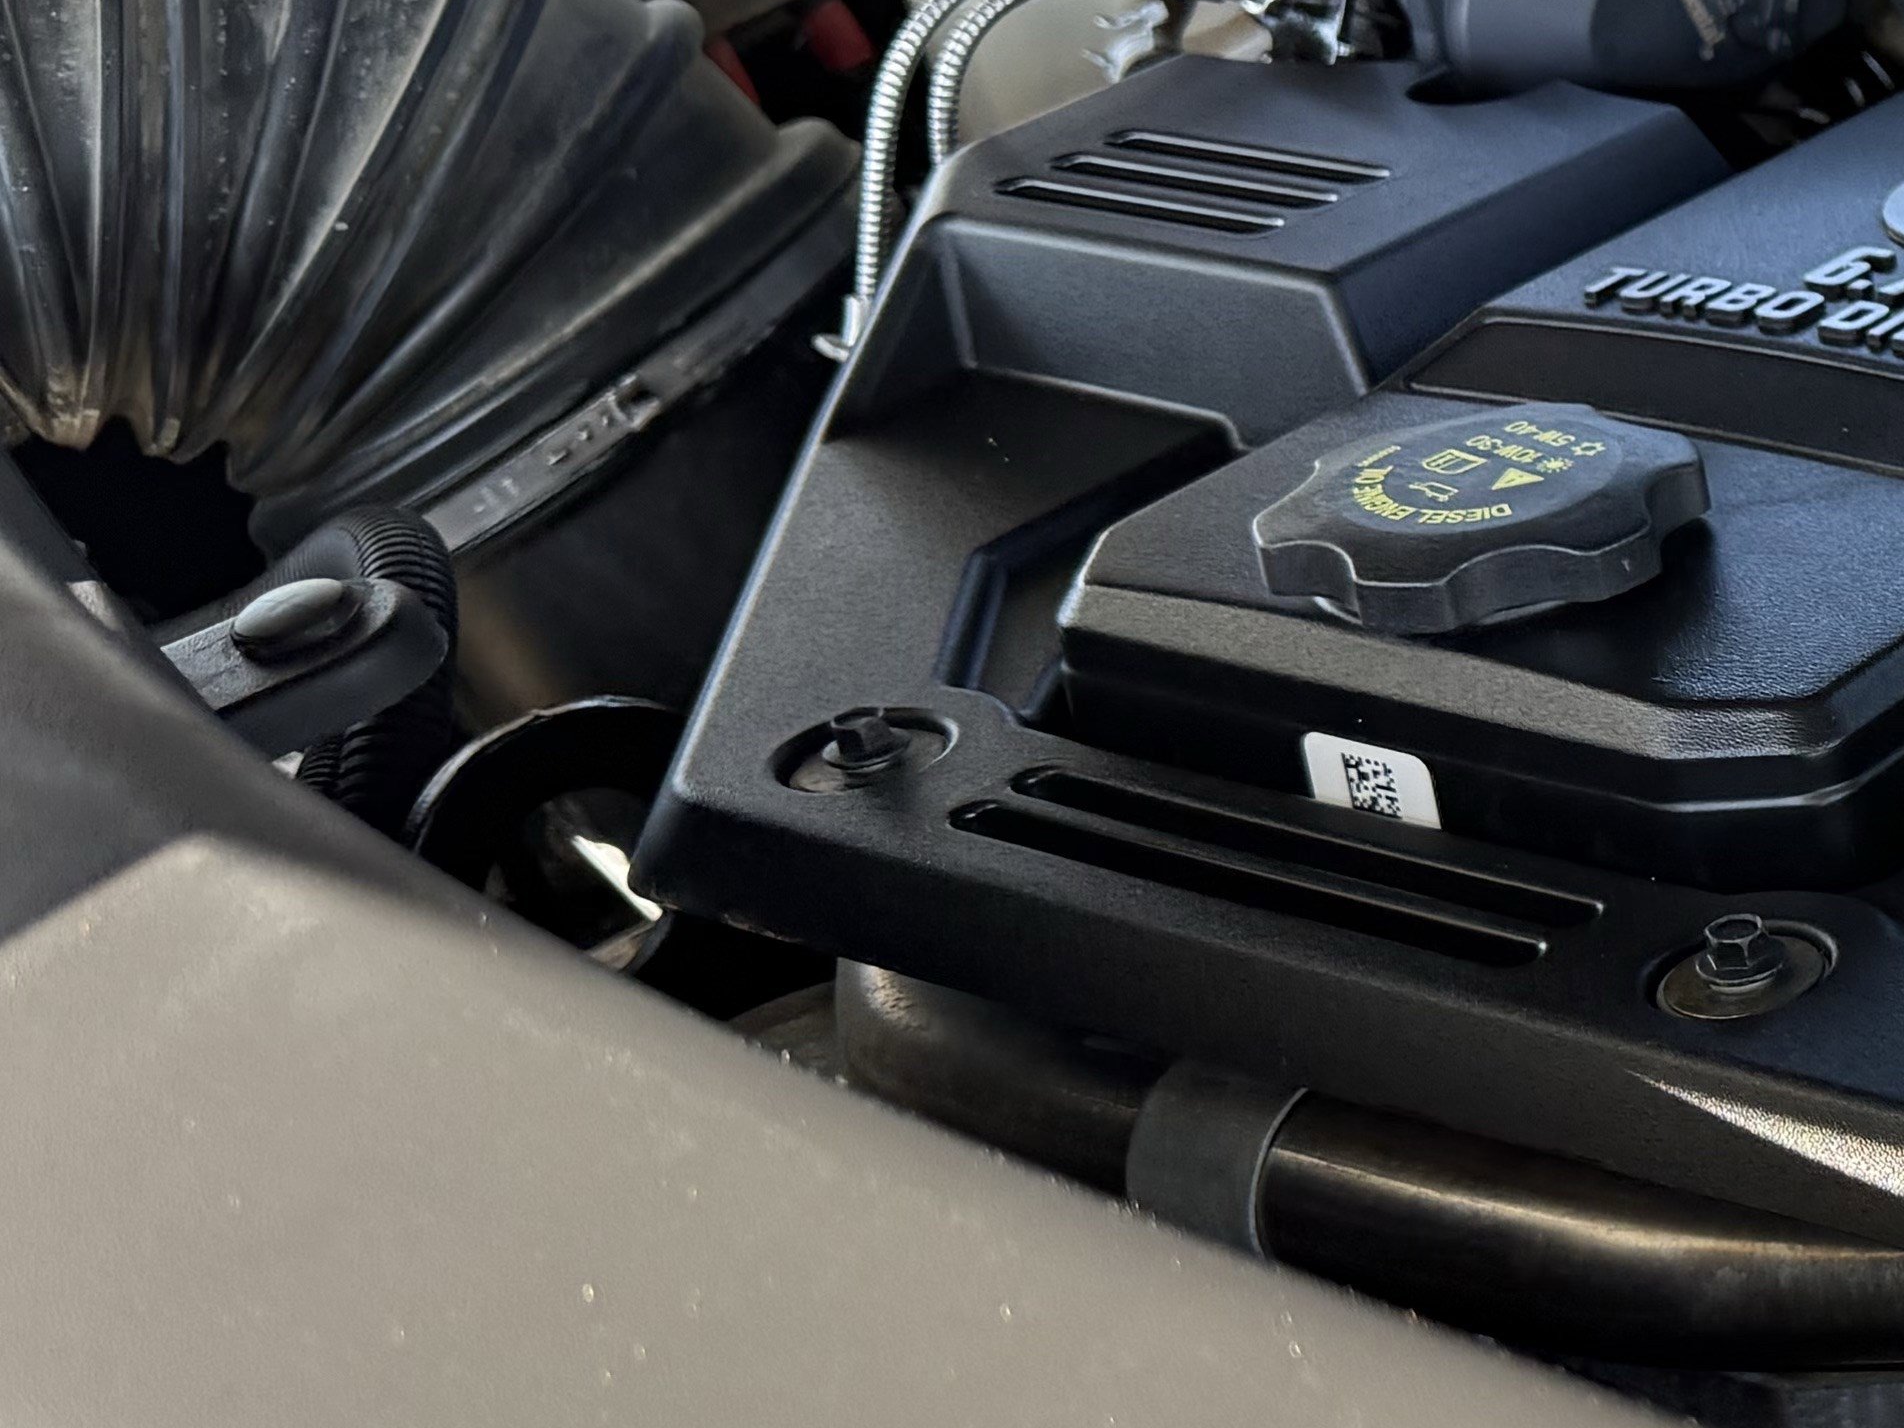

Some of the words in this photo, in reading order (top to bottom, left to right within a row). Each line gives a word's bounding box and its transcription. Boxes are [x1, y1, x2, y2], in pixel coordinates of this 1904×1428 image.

[1584, 266, 1827, 336] TURBO
[1504, 420, 1576, 447] 5W-40
[1352, 483, 1417, 521] ENGINE
[1418, 503, 1513, 524] DIESEL
